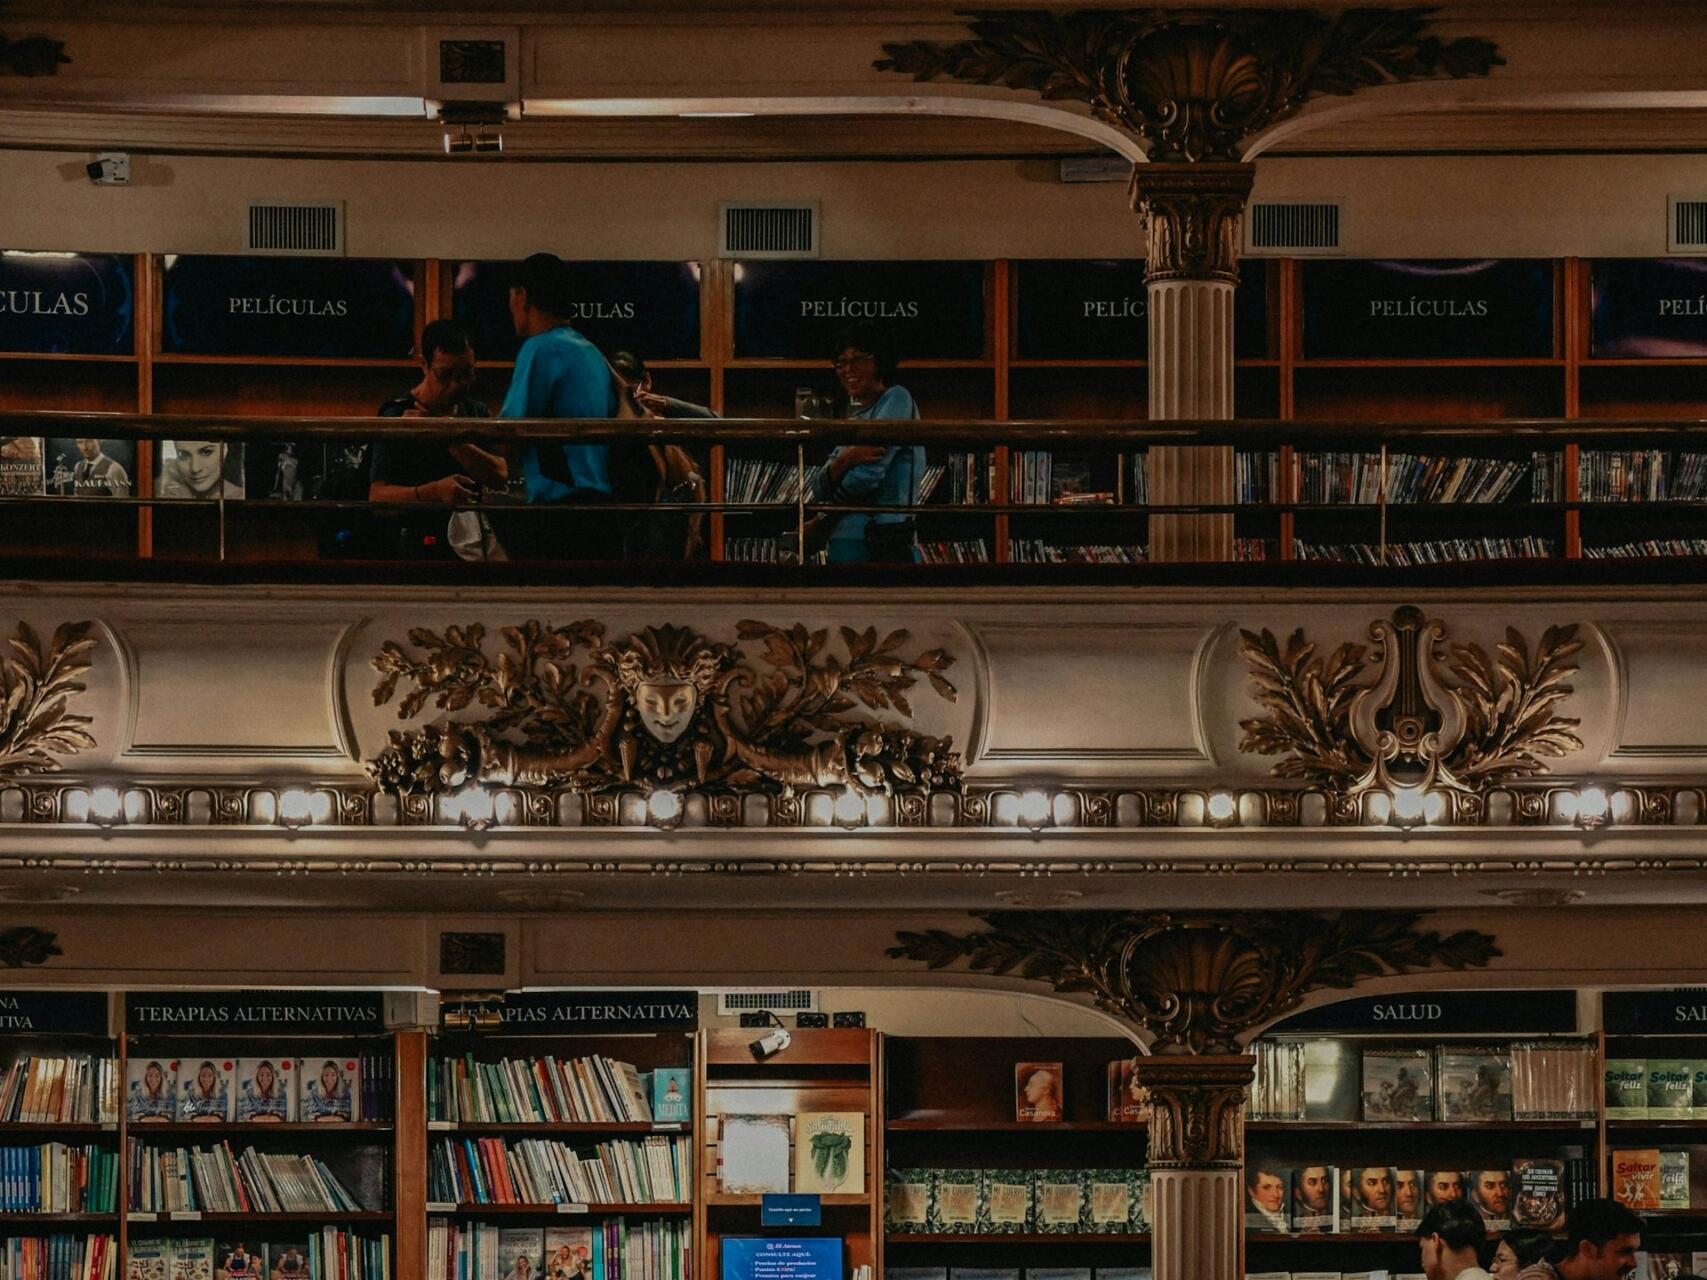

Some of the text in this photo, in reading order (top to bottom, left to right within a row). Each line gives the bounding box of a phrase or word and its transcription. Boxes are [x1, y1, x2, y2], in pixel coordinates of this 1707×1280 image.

[229, 294, 347, 316] PELÍCULAS
[800, 297, 919, 318] PELÍCULAS
[1369, 296, 1488, 317] PELÍCULAS
[134, 1006, 377, 1022] TERAPIAS ALTERNATIVAS
[552, 1005, 693, 1022] ALTERNATIVA
[1373, 1003, 1442, 1021] SALUD
[1619, 1080, 1642, 1091] feliz
[658, 1103, 688, 1116] MEDITA
